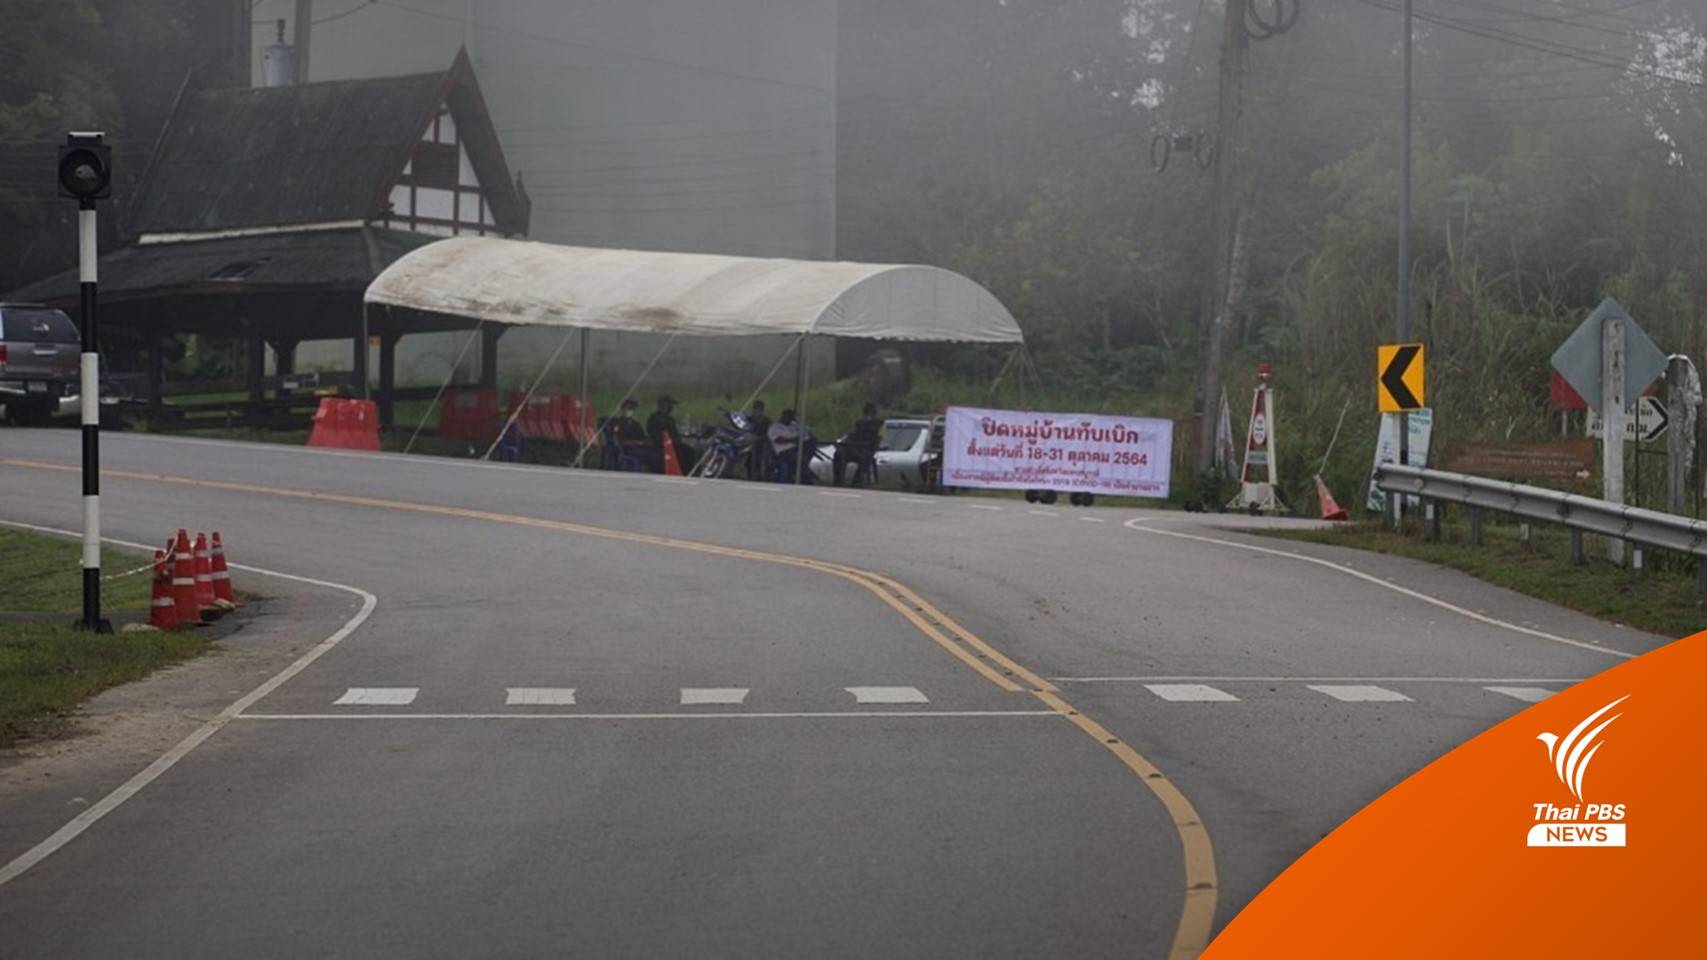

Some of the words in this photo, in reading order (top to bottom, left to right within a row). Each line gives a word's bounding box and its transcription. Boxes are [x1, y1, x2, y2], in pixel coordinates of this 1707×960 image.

[980, 416, 1139, 445] ปิดหมู่บ้านทับเบิก
[967, 438, 1024, 459] ตั้งแต่วันที่
[1027, 446, 1063, 461] 18-31
[1068, 449, 1110, 466] ตุลาคม
[1113, 452, 1148, 466] 2564
